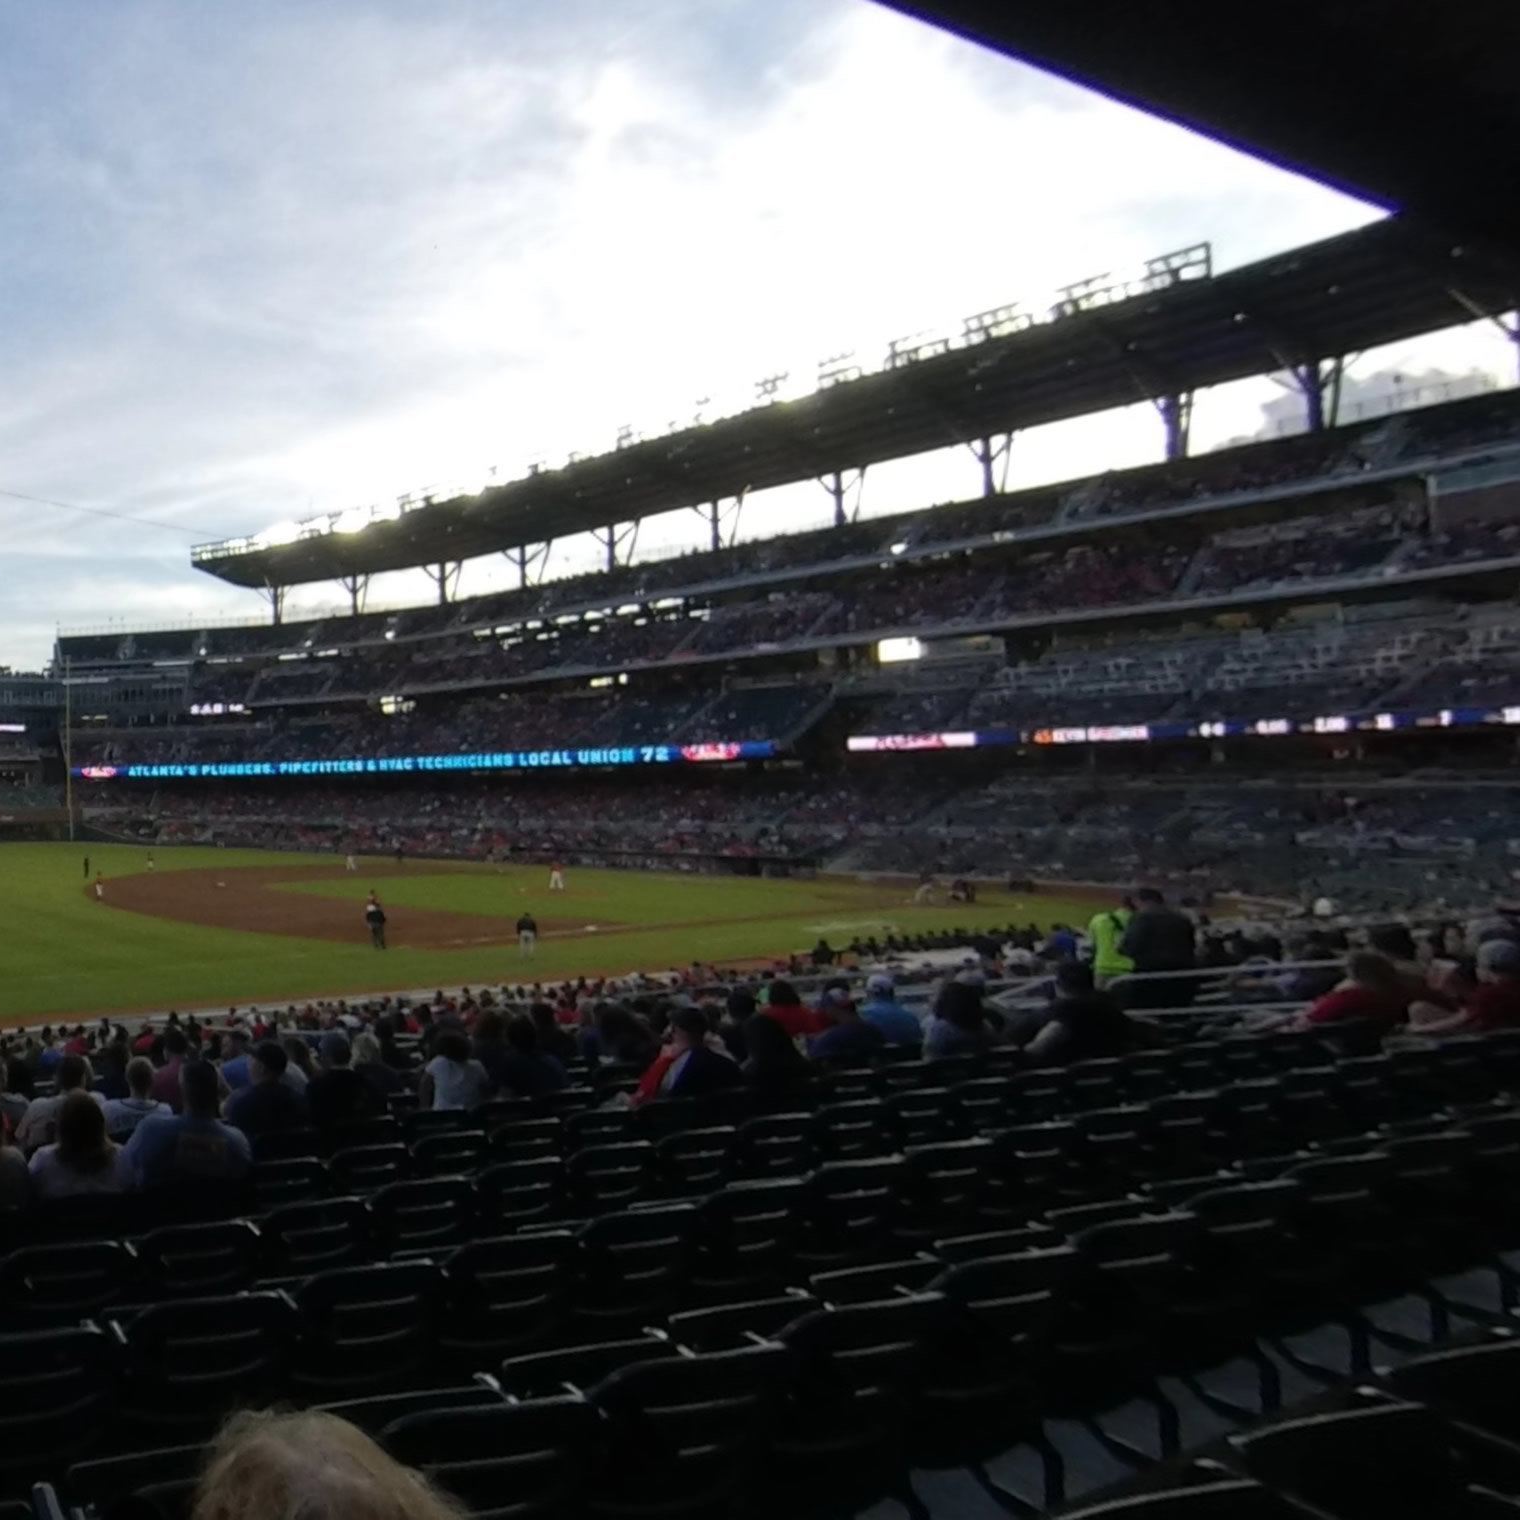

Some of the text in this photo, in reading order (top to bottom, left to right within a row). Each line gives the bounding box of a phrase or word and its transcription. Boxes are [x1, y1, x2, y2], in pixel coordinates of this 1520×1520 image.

[128, 764, 197, 777] ATLANTA'S
[279, 759, 363, 774] PIPEFITTERS
[367, 758, 377, 771] &
[379, 756, 412, 771] HVAC
[417, 752, 513, 770] TECHNICIANS
[519, 749, 572, 767] LOCAL
[577, 748, 635, 765] UNION
[641, 745, 669, 763] 72
